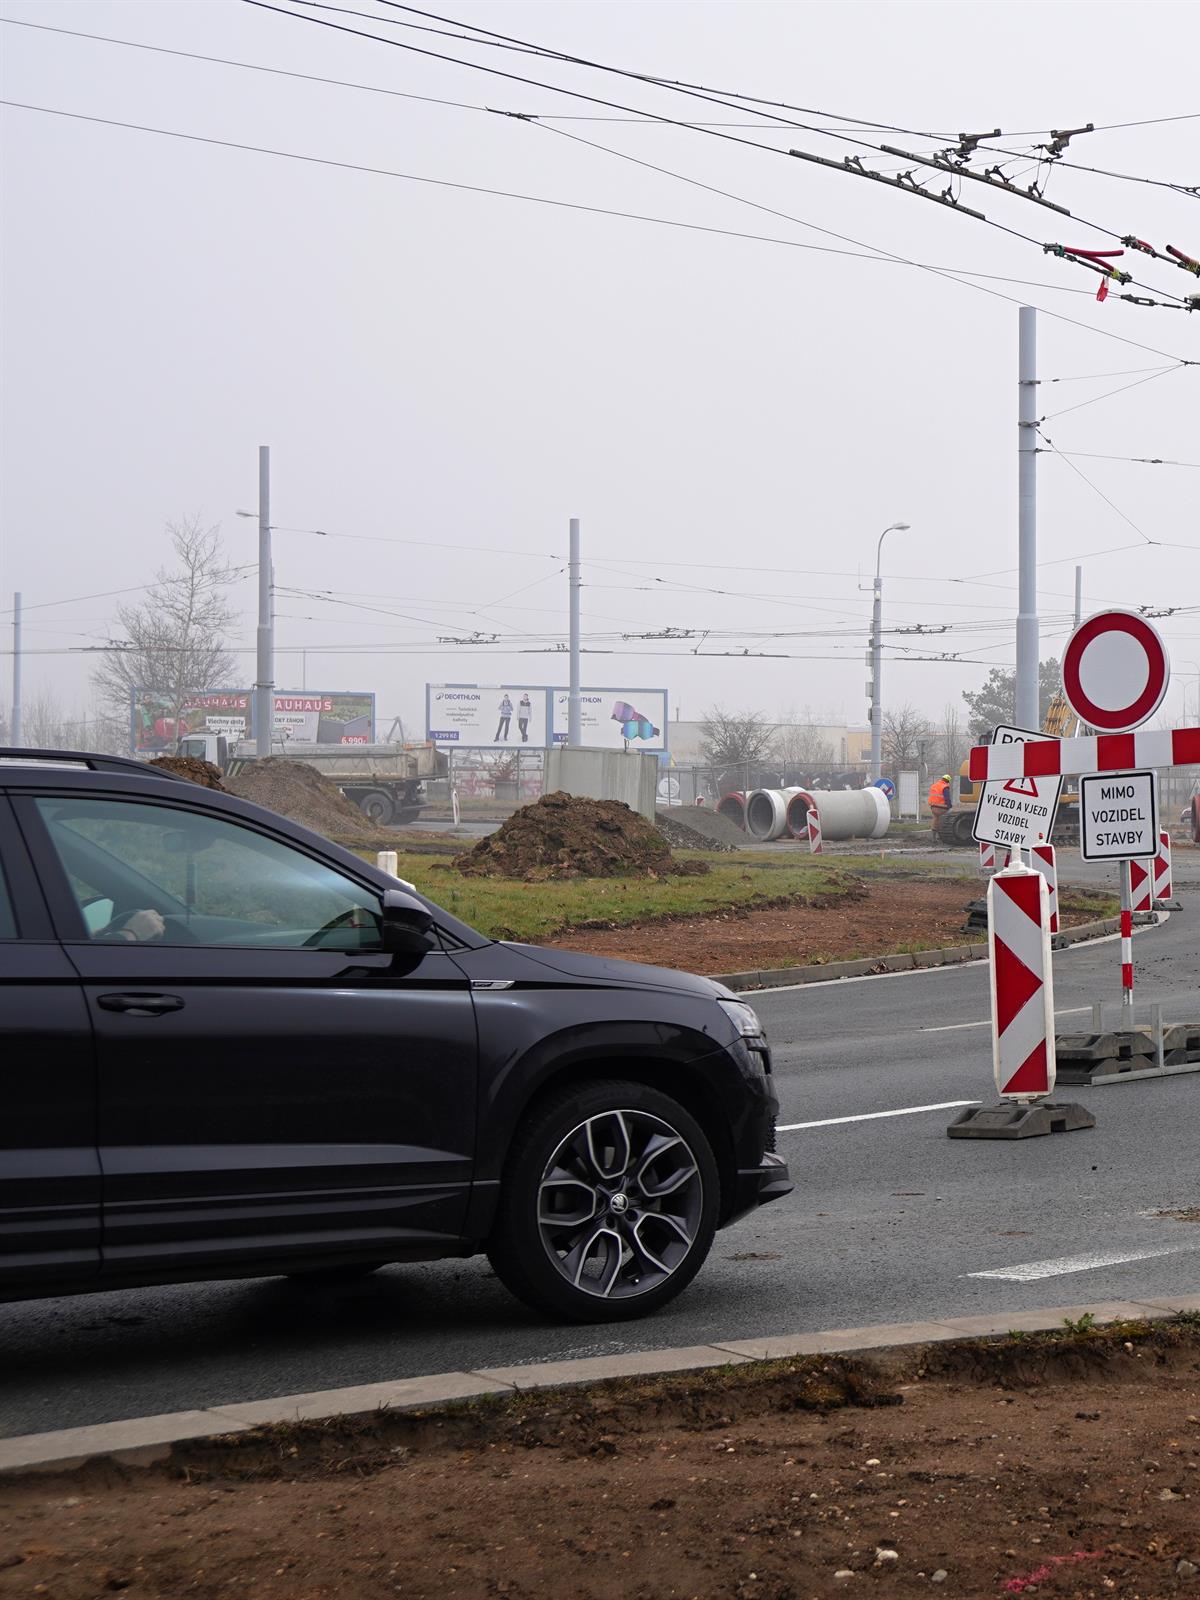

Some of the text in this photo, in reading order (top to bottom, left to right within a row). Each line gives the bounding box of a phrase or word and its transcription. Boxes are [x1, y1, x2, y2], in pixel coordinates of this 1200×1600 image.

[275, 699, 333, 711] AUHAUS
[1101, 785, 1135, 800] MIMO
[987, 793, 1048, 817] VÝJEZD A VJEZD
[997, 812, 1029, 829] VOZIDEL
[1091, 808, 1146, 824] VOZIDEL
[994, 829, 1026, 845] STAVBY
[1096, 831, 1144, 846] STAVBY
